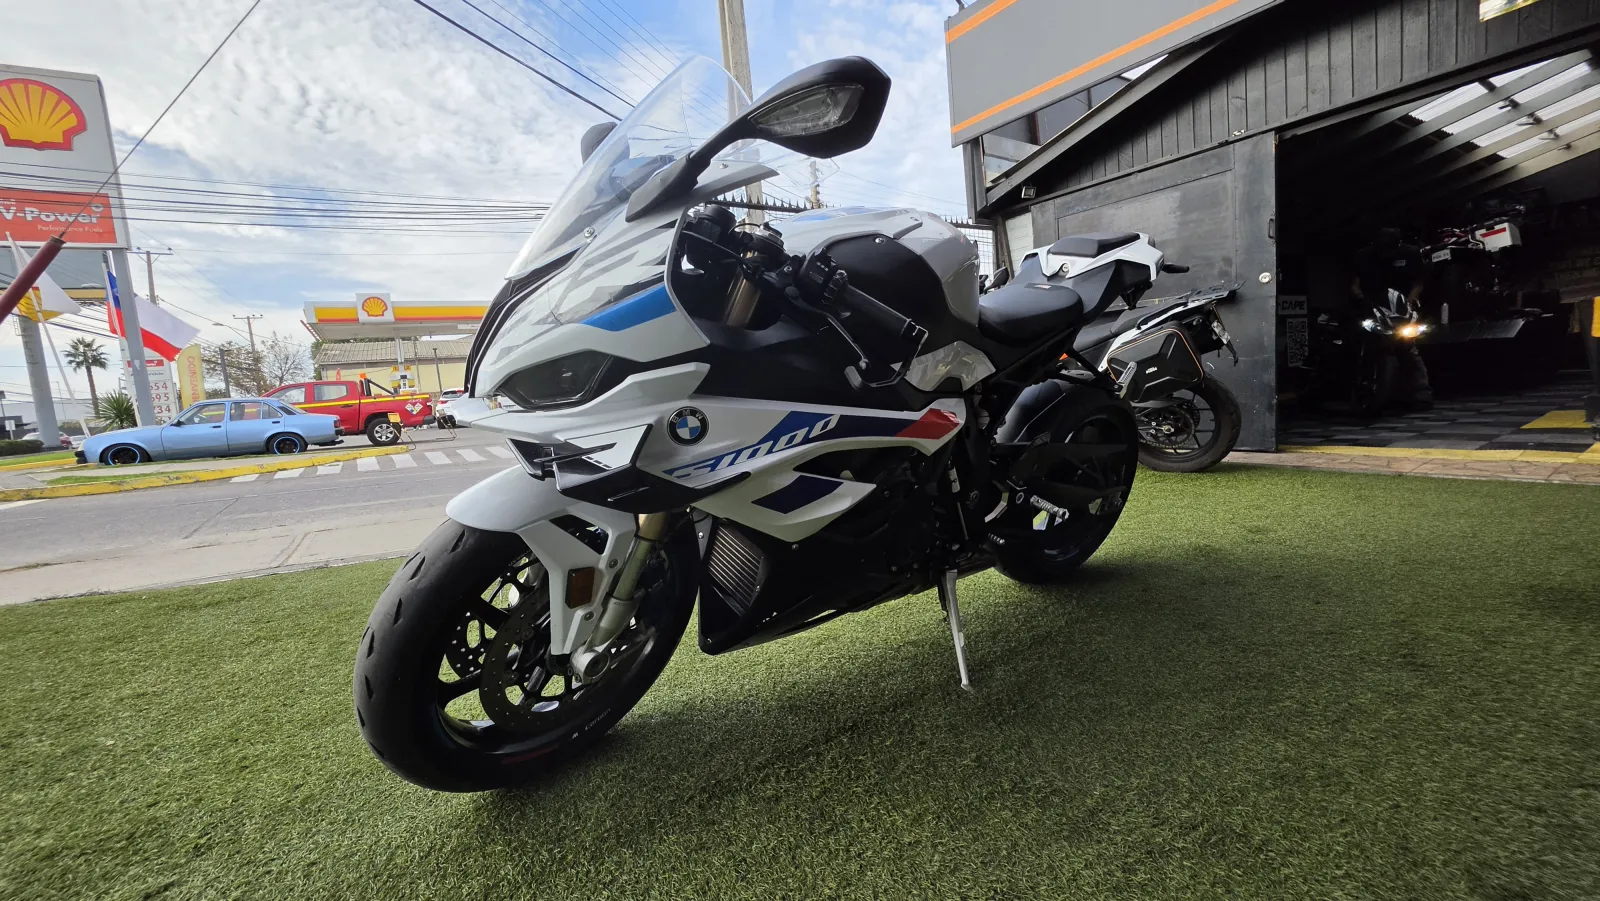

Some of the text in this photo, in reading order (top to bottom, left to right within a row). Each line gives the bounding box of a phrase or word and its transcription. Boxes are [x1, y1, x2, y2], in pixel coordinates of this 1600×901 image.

[0, 206, 100, 223] V-Power
[85, 225, 103, 233] Fuels
[1279, 300, 1305, 310] CAPE
[187, 356, 200, 402] IENVENIDO
[671, 408, 705, 424] BMW
